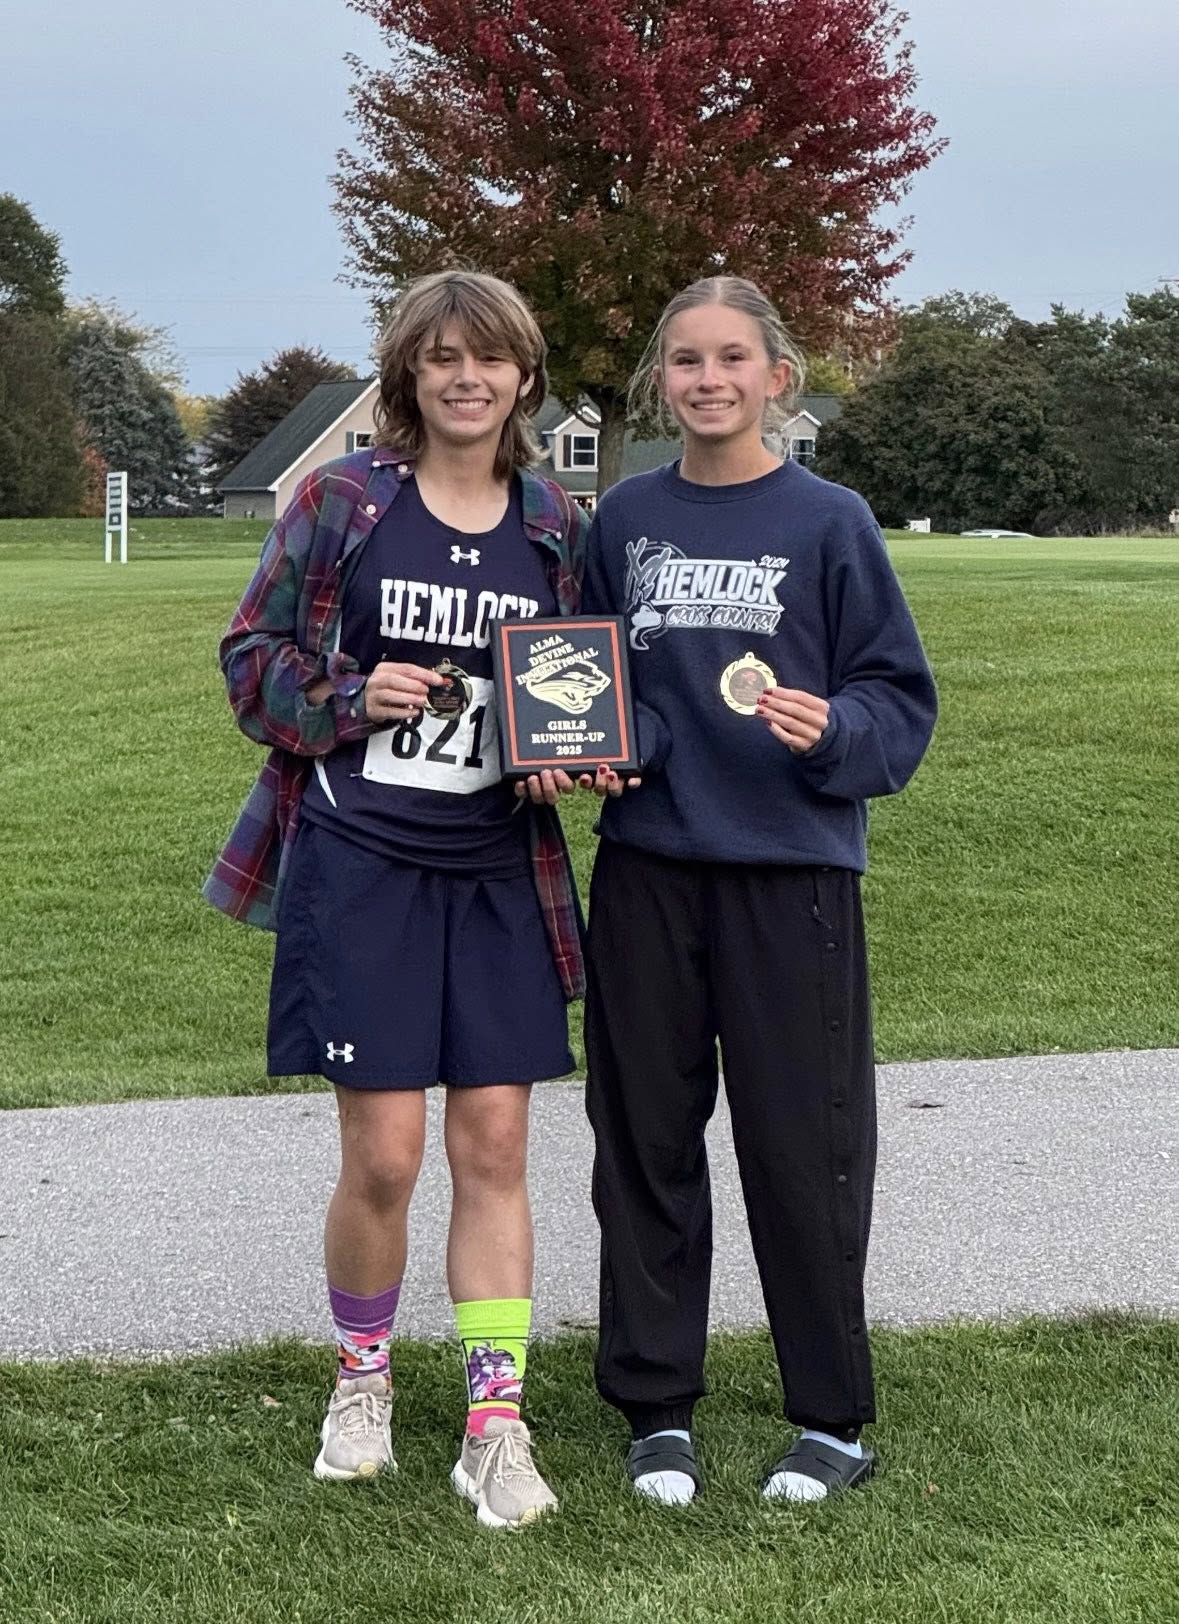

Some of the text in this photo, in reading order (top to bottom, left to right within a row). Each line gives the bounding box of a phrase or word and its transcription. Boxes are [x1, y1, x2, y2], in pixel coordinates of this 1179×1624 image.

[758, 554, 791, 569] 2024
[655, 564, 788, 606] HEMLOCK
[666, 604, 781, 634] CROSS COUNTRY
[528, 642, 575, 667] DEVINE
[529, 634, 565, 655] ALMA
[547, 719, 588, 731] GIRLS
[391, 704, 486, 769] 821
[531, 732, 606, 744] RUNNER-UP
[555, 745, 583, 756] 2025
